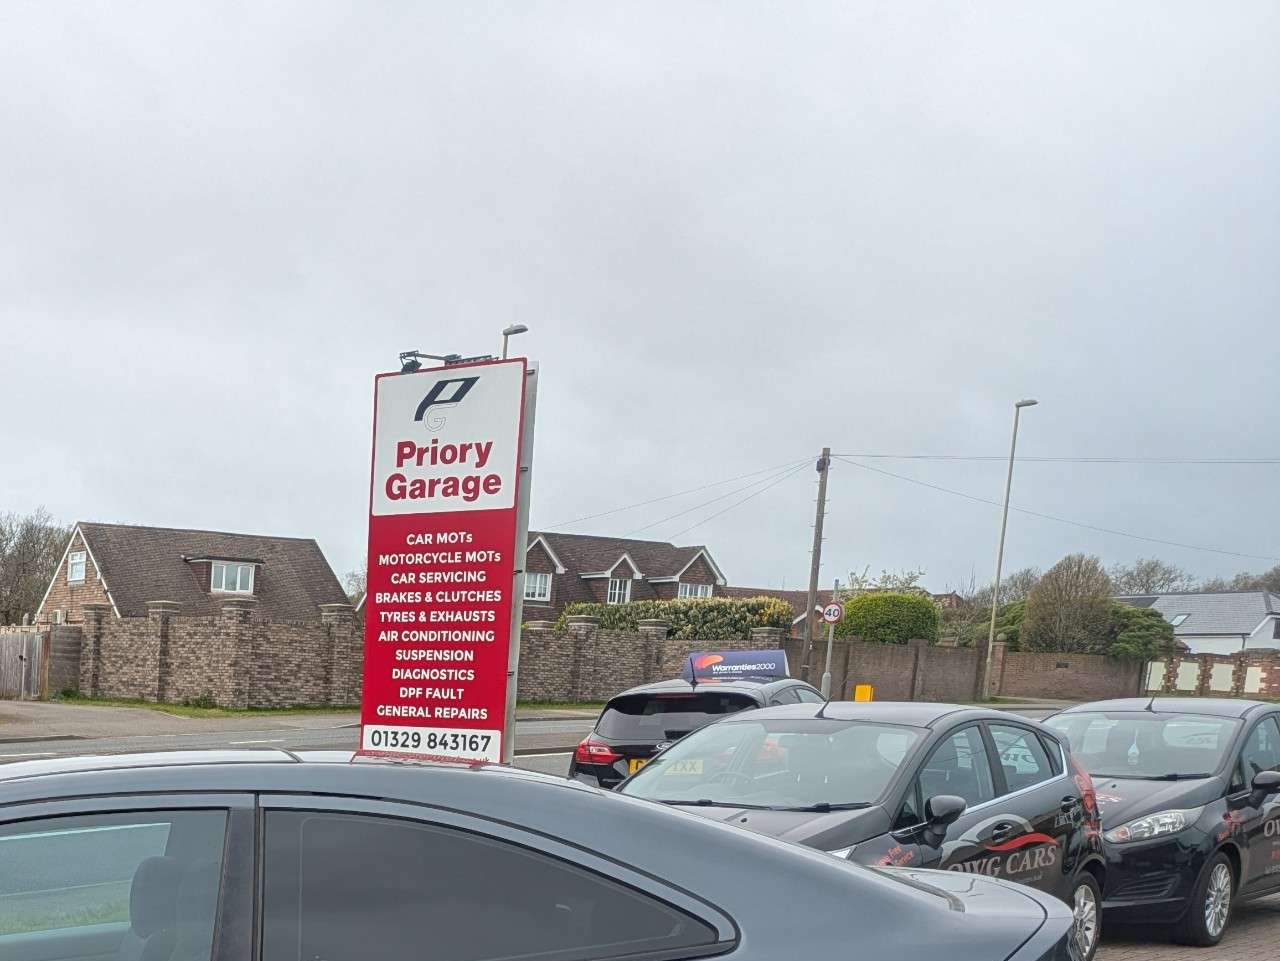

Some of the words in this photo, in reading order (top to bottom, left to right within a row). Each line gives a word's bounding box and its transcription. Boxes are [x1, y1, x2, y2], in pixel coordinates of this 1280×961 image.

[396, 439, 493, 468] Priory
[385, 473, 502, 502] Garage
[406, 533, 433, 545] CAR
[436, 531, 473, 544] MOTs
[378, 551, 462, 566] MOTORCYCLE
[465, 550, 501, 563] MOTs
[391, 573, 416, 584] CAR
[419, 571, 486, 583] SERVICING
[375, 591, 422, 604] BRAKES
[424, 592, 433, 603] &
[435, 590, 502, 603] CLUTCHES
[380, 611, 416, 622] TYRES
[418, 611, 427, 622] &
[429, 610, 496, 622] EXHAUSTS
[825, 608, 840, 617] 40
[378, 630, 399, 642] AIR
[401, 630, 495, 642] CONDITIONING
[395, 649, 474, 661] SUSPENSION
[392, 668, 475, 681] DIAGNOSTICS
[399, 687, 423, 698] DPF
[425, 687, 465, 700] FAULT
[376, 704, 432, 718] GENERAL
[434, 706, 488, 720] REPAIRS
[371, 729, 421, 749] 01329
[427, 732, 492, 752] 843167
[1006, 845, 1057, 874] CARS
